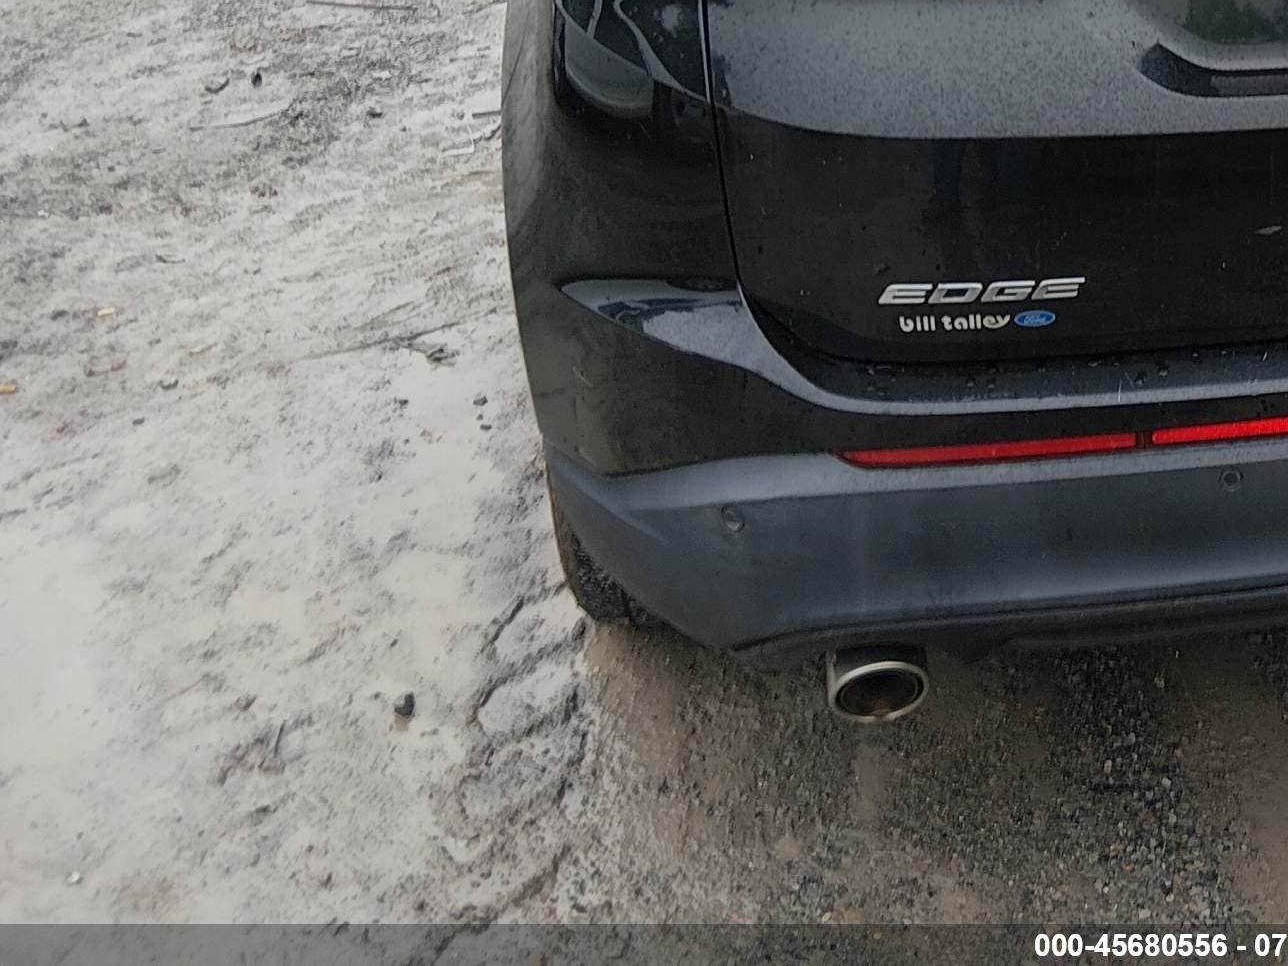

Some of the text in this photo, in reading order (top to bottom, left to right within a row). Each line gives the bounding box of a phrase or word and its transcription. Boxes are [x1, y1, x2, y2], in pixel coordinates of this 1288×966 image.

[877, 276, 1087, 305] EDGE
[900, 315, 936, 333] bill
[941, 313, 1011, 331] talley
